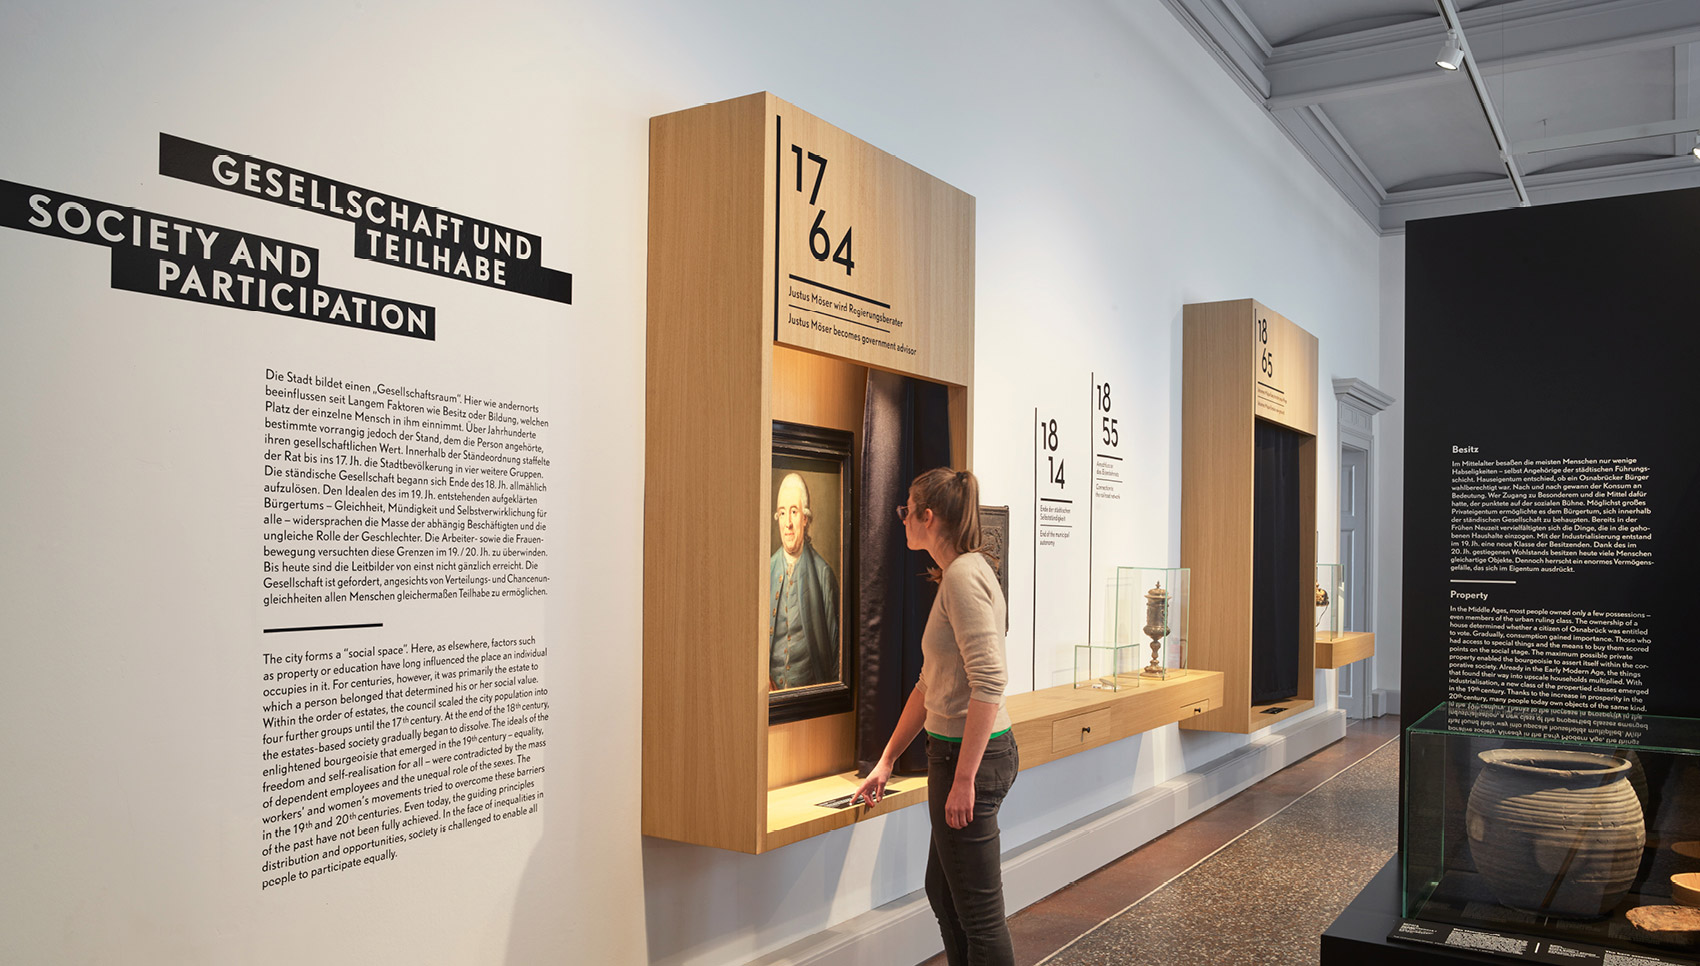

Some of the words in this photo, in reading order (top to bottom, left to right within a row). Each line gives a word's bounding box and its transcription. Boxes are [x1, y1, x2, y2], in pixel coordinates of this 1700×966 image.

[792, 144, 828, 206] 17
[212, 154, 462, 245] GESELLSCHAFT
[472, 224, 533, 260] UND
[28, 194, 220, 260] SOCIETY
[230, 237, 312, 280] AND
[808, 209, 855, 276] 64
[366, 230, 507, 286] TEILHABE
[159, 260, 428, 335] PARTICIPATION
[788, 286, 810, 302] Justus
[811, 294, 832, 308] Möser
[834, 300, 848, 312] wird
[848, 304, 904, 328] Regierungsberater
[788, 313, 810, 328] Justus
[810, 320, 832, 334] Möser
[833, 327, 861, 342] becomes
[862, 334, 896, 352] government
[897, 342, 917, 356] advisor
[1258, 318, 1268, 344] 18
[1262, 348, 1273, 378] 65
[265, 368, 284, 381] Die
[286, 371, 312, 385] Stadt
[315, 375, 342, 389] bildet
[344, 381, 370, 392] einen
[464, 394, 482, 405] Hier
[483, 399, 496, 408] wie
[498, 400, 539, 413] andernorts
[1096, 382, 1112, 412] 18
[265, 400, 290, 414] Platz
[292, 404, 309, 415] der
[311, 407, 352, 420] einzelne
[354, 410, 390, 424] Mensch
[392, 415, 401, 424] in
[403, 416, 419, 427] ihm
[421, 419, 463, 431] einnimmt.
[465, 422, 486, 433] Über
[487, 424, 536, 439] Jahrhunderte
[1042, 418, 1058, 452] 18
[1102, 416, 1119, 448] 55
[1452, 445, 1479, 454] Besitz
[264, 464, 282, 476] Die
[285, 467, 336, 480] ständische
[338, 469, 394, 483] Gesellschaft
[396, 473, 428, 486] begann
[430, 476, 446, 486] sich
[449, 476, 469, 487] Ende
[470, 478, 484, 488] des
[485, 479, 496, 489] 18.
[498, 480, 508, 489] Jh.
[509, 481, 546, 491] allmählich
[1048, 456, 1066, 490] 14
[263, 592, 322, 606] gleichheiten
[324, 591, 346, 602] allen
[349, 590, 395, 601] Menschen
[396, 588, 457, 602] gleichermaßen
[458, 588, 490, 598] Teilhabe
[501, 586, 547, 598] ermöglichen.
[1450, 590, 1488, 600] Property
[262, 653, 282, 664] The
[284, 652, 303, 664] city
[305, 650, 333, 661] forms
[410, 643, 434, 653] Here,
[447, 639, 489, 650] elsewhere,
[491, 638, 517, 647] factors
[518, 635, 535, 645] such
[1550, 674, 1587, 682] households
[306, 802, 325, 816] and
[371, 787, 421, 803] movements
[423, 781, 442, 794] tried
[454, 775, 493, 788] overcome
[494, 771, 515, 780] these
[516, 766, 545, 776] barriers
[261, 853, 319, 872] distribution
[322, 845, 340, 858] and
[342, 834, 406, 854] opportunities,
[408, 827, 438, 840] society
[439, 824, 446, 832] is
[447, 813, 491, 830] challenged
[502, 807, 527, 819] enable
[528, 804, 537, 813] all
[298, 870, 308, 879] to
[310, 858, 361, 878] participate
[363, 848, 397, 864] equally.
